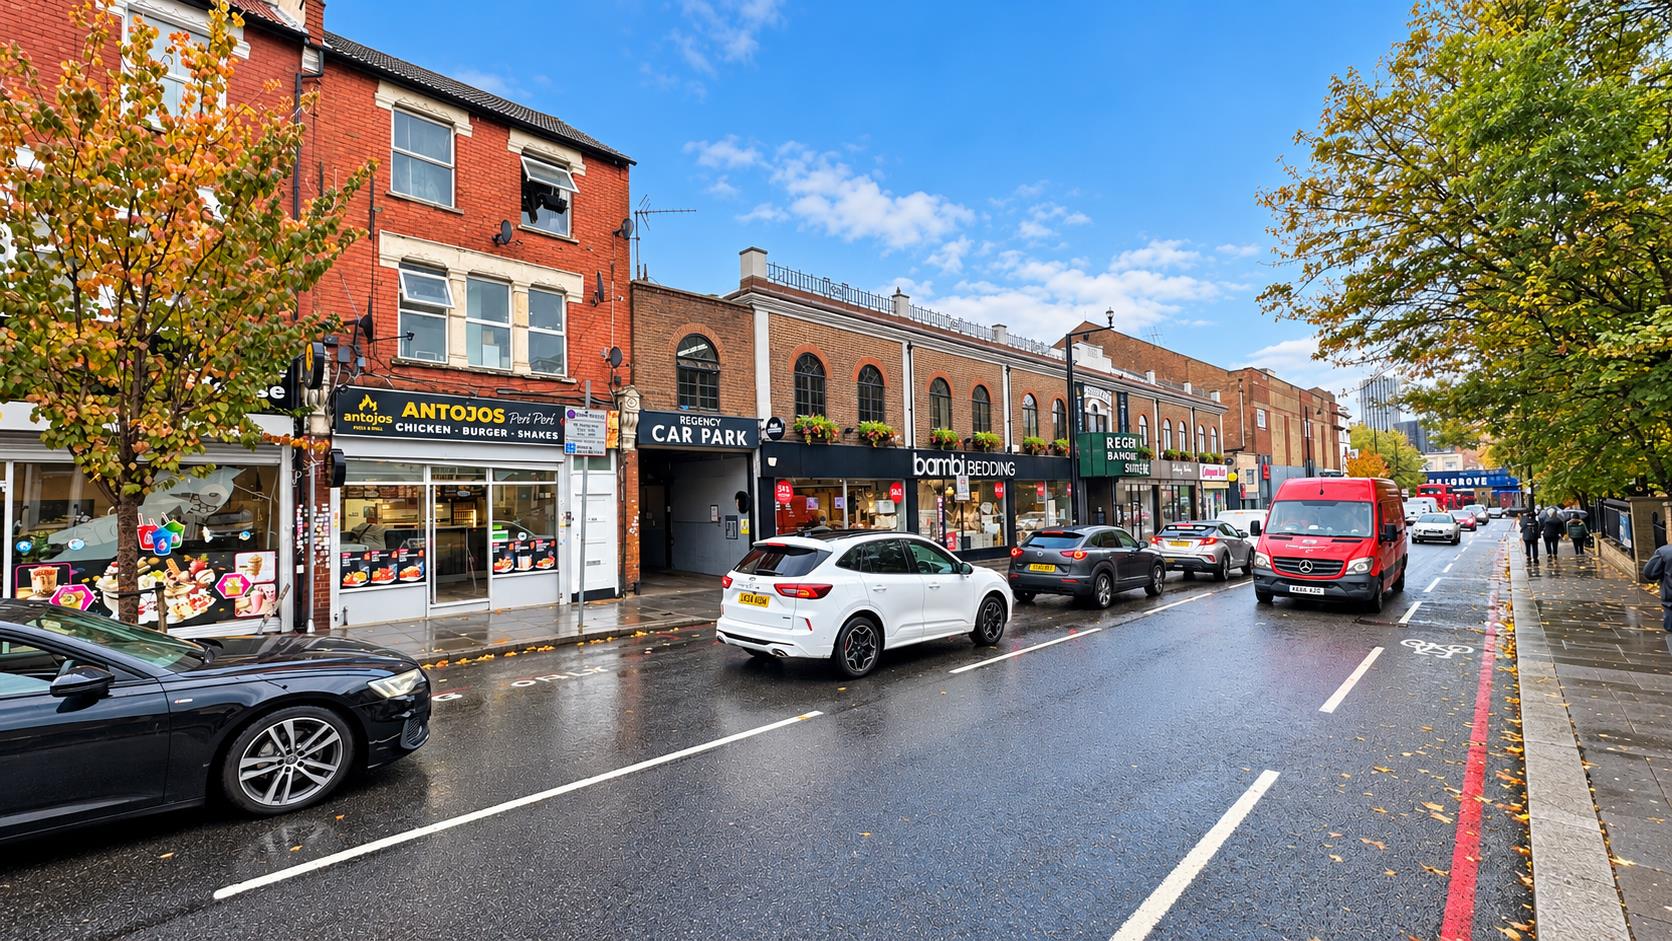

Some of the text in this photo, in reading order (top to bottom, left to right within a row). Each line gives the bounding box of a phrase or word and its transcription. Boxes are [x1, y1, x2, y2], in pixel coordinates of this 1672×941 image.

[343, 412, 393, 425] antojos
[401, 401, 555, 426] ANTOJOS Peri Peri
[679, 415, 721, 427] REGENCY
[395, 422, 451, 435] CHICKEN
[462, 426, 508, 438] BURGER
[517, 429, 559, 440] SHAKES
[651, 424, 693, 443] CAR
[701, 428, 748, 446] PARK
[913, 452, 1016, 477] bambi BEDDING
